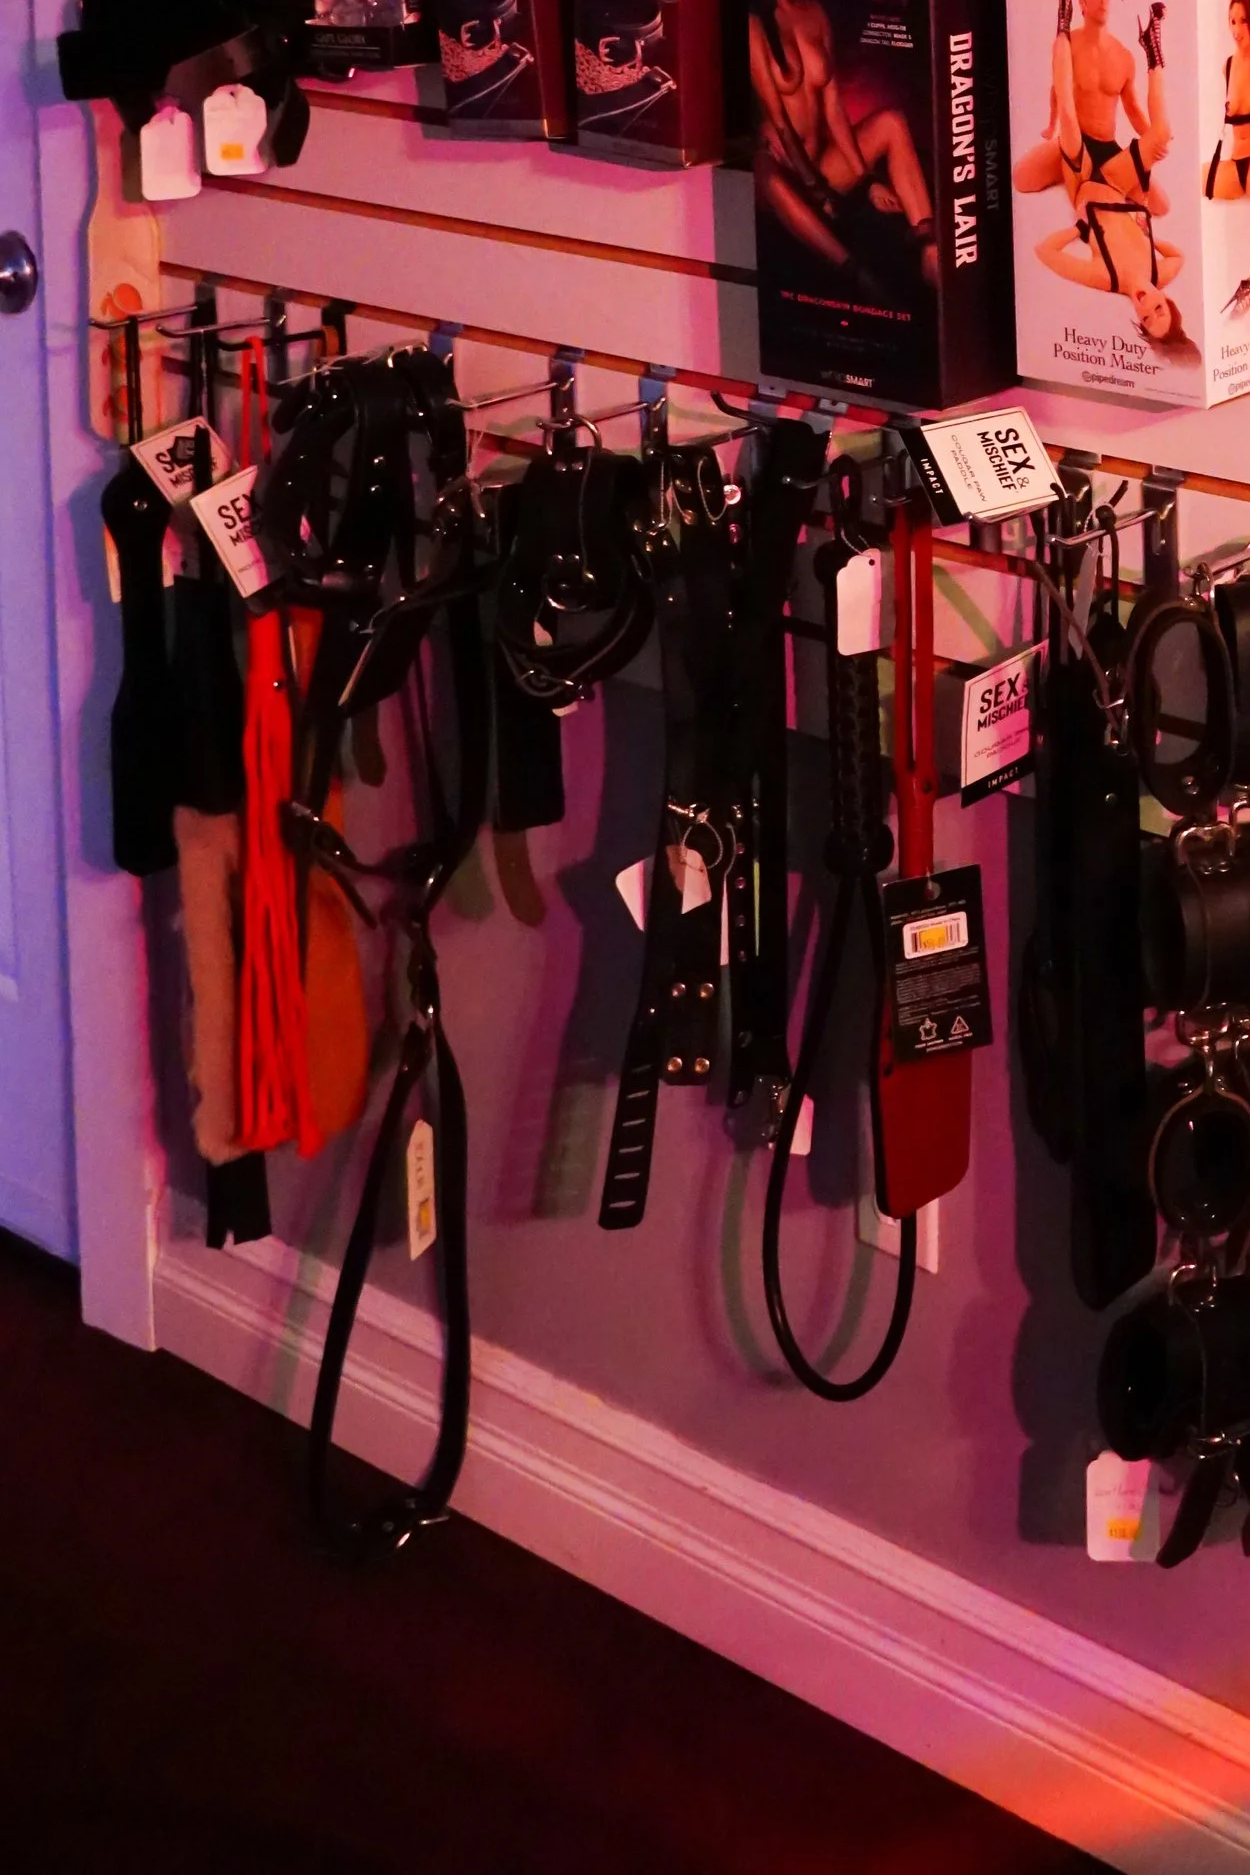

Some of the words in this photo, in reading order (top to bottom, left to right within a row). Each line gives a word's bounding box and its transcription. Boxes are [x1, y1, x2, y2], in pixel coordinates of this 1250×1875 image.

[949, 31, 977, 183] DRAGON'S
[953, 195, 979, 268] LAIR
[897, 312, 912, 321] SET
[1053, 343, 1106, 367] Position
[1110, 353, 1160, 376] Master
[1064, 327, 1108, 353] Heavy
[1111, 335, 1148, 360] Duty
[1221, 342, 1250, 361] Heavy
[1213, 362, 1248, 382] Position
[920, 458, 945, 495] IMPACT
[950, 450, 973, 491] PADDLE
[951, 434, 976, 479] COUGAR
[973, 480, 987, 503] PAW
[977, 431, 1018, 492] MISCHIEF
[995, 428, 1036, 475] SEX
[1017, 476, 1030, 490] &
[979, 672, 1021, 714] SEX
[988, 766, 1019, 789] IMPACT
